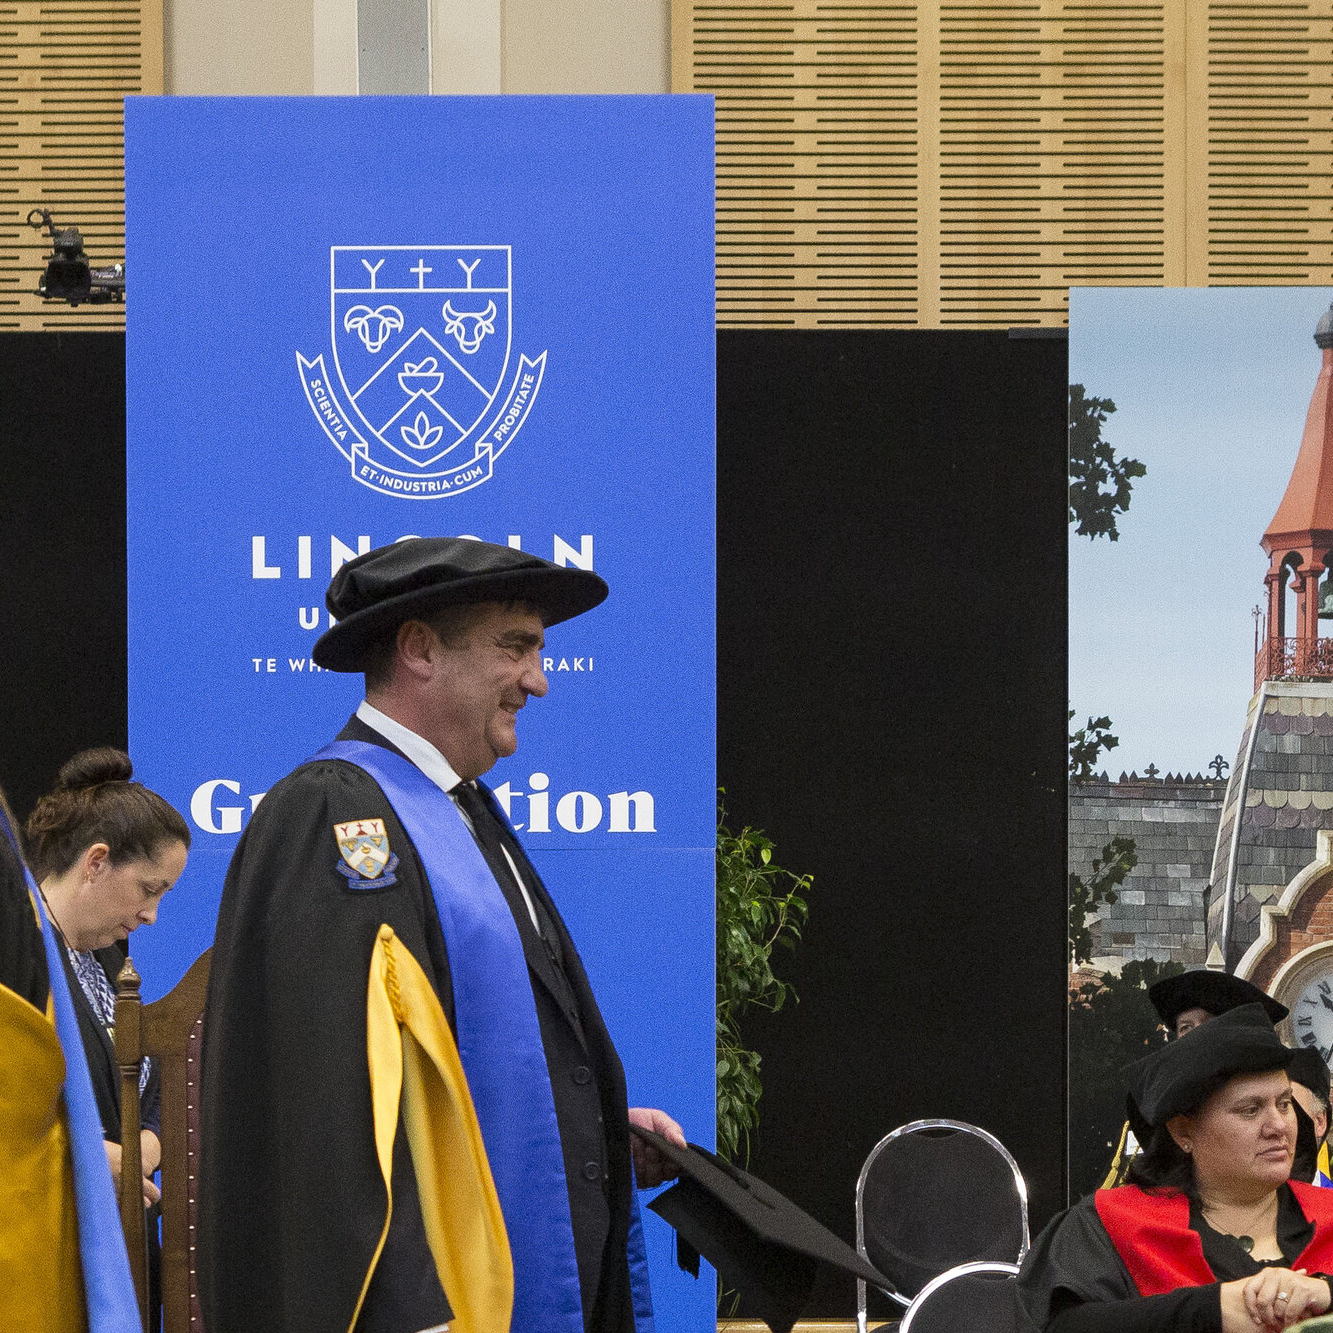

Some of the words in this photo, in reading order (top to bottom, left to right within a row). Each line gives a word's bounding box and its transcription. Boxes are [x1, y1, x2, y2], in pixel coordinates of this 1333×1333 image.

[310, 379, 348, 441] SCIENTIA
[493, 373, 535, 442] PROBITATE
[252, 534, 594, 579] LINN
[252, 658, 277, 673] TE
[543, 657, 594, 671] RAKI
[190, 772, 657, 834] Gtion
